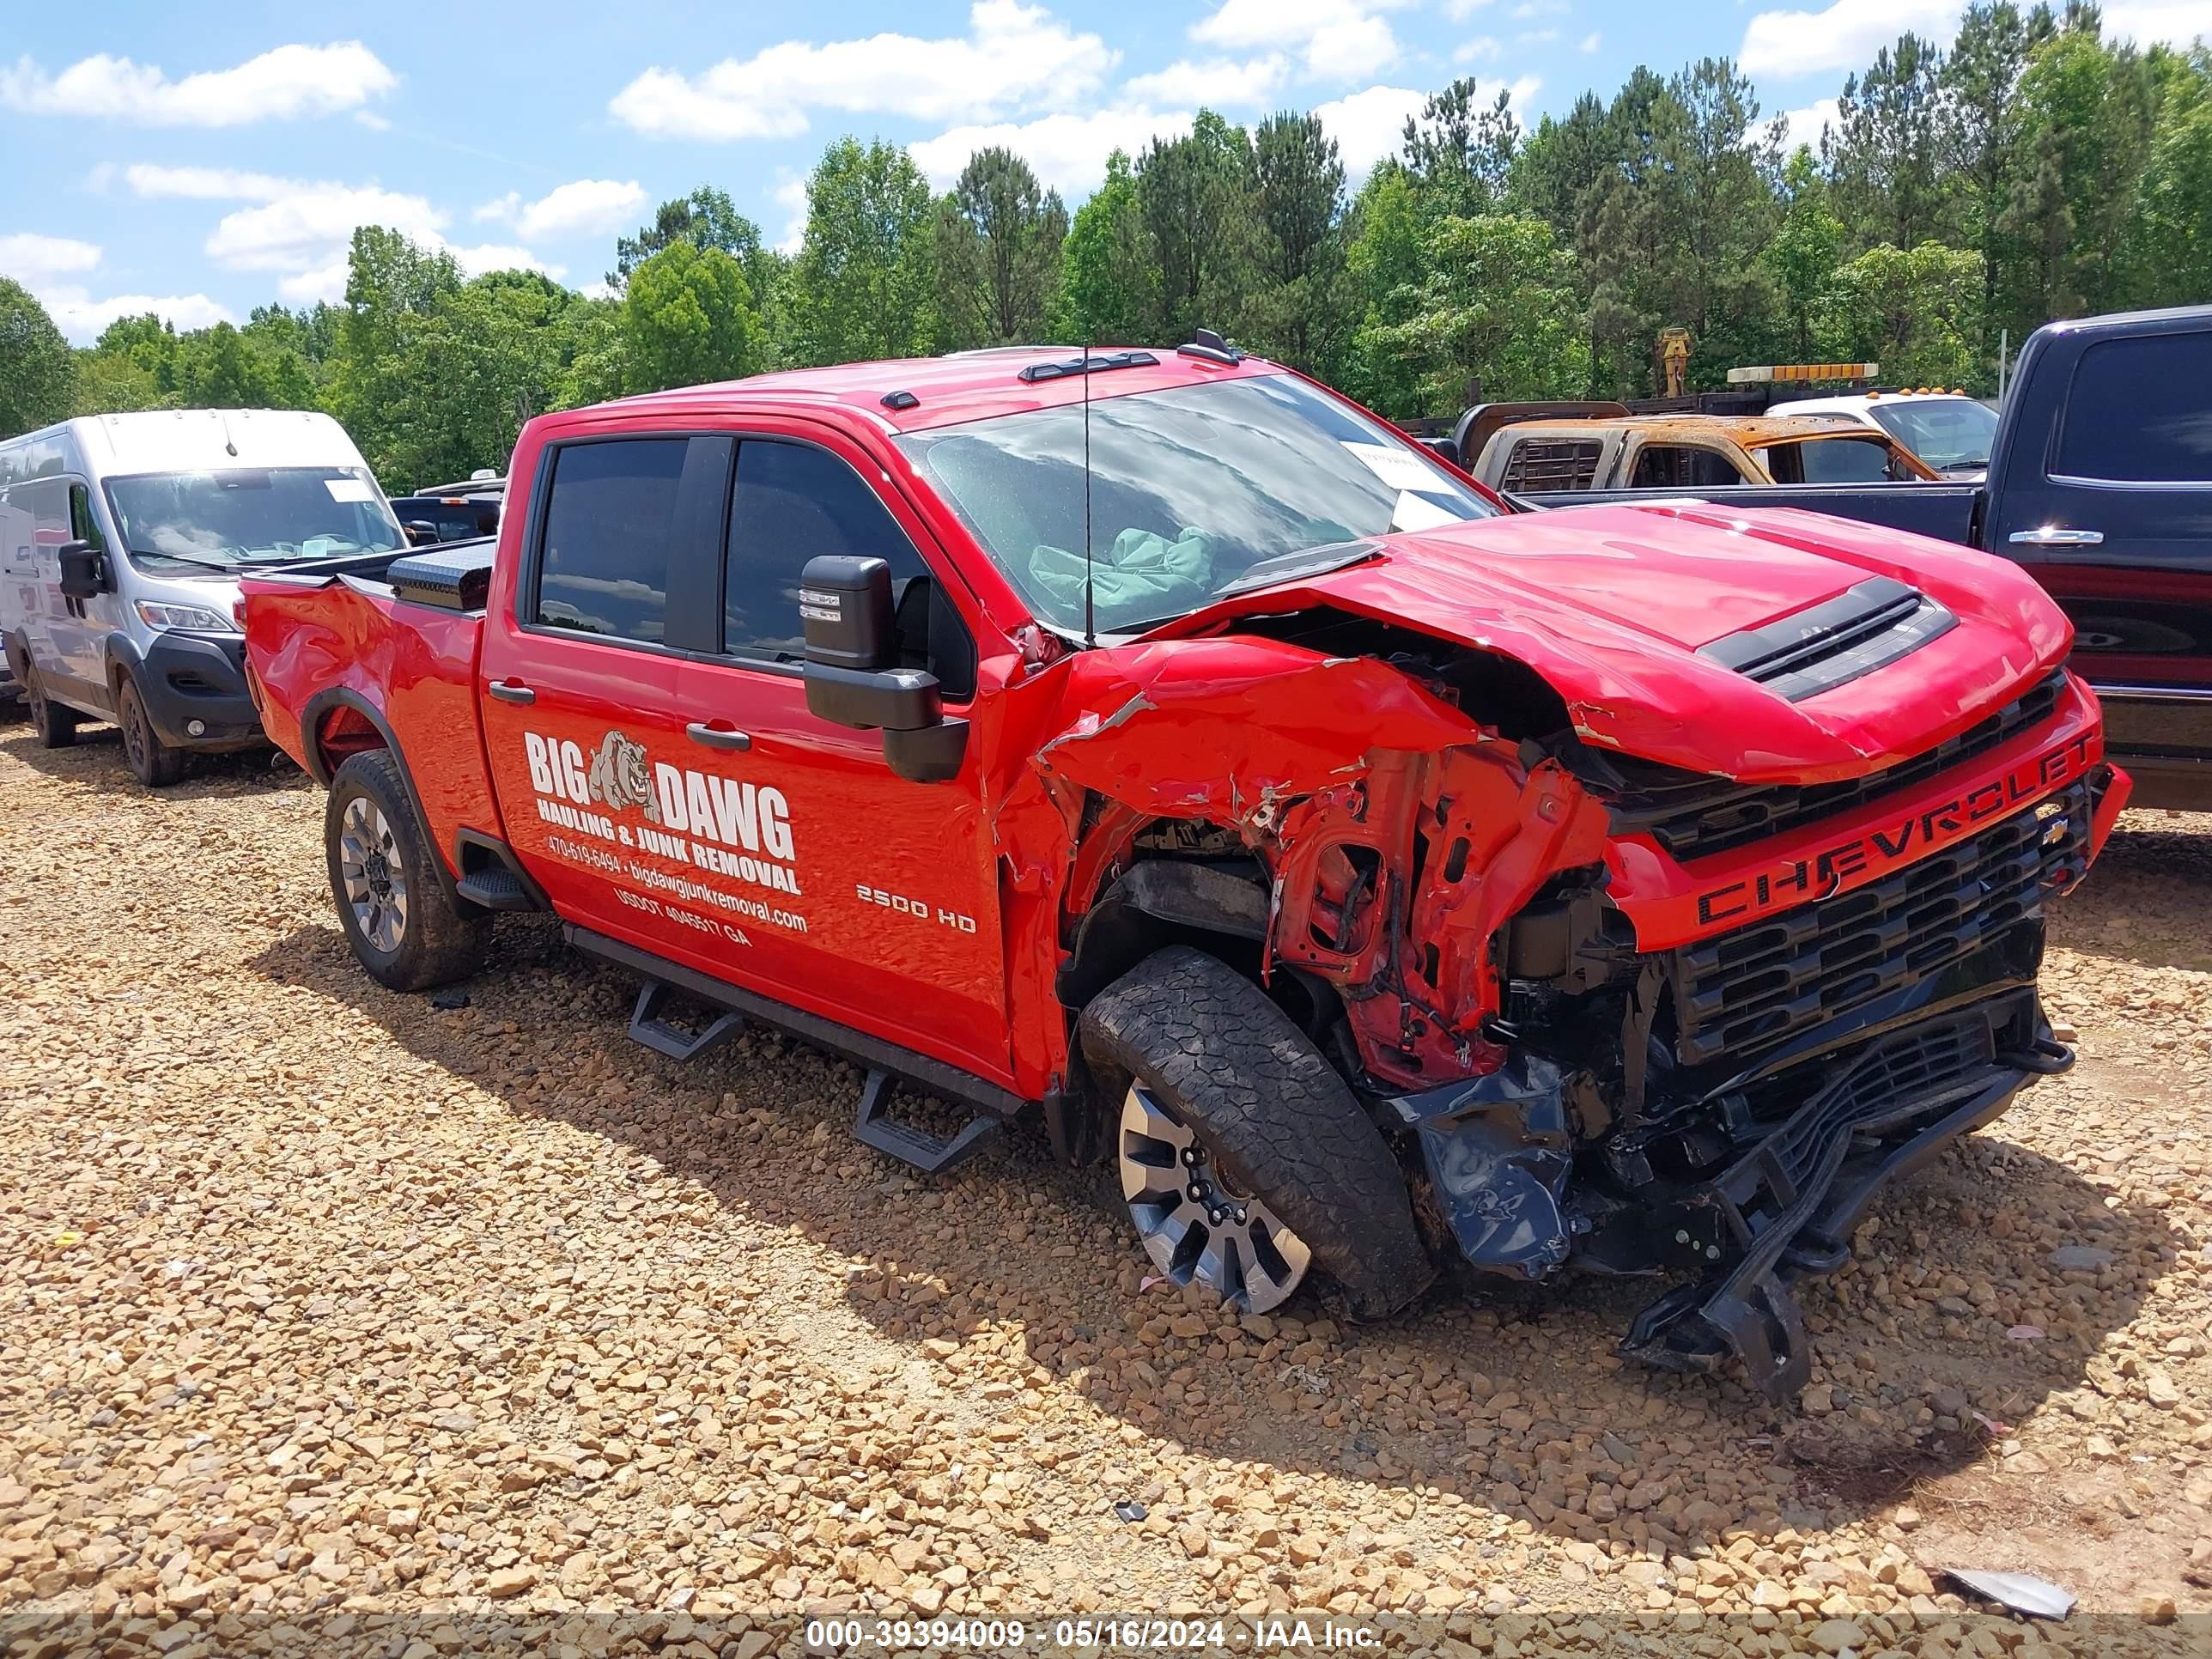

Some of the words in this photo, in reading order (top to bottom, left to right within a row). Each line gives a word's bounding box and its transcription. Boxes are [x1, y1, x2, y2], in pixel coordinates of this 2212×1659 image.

[524, 731, 591, 805] BIG
[655, 762, 796, 861] DAWG
[1697, 733, 2091, 925] CHEVROLET
[537, 799, 616, 842] HAULING
[618, 825, 634, 847] &
[636, 827, 690, 864] JUNK
[691, 842, 803, 896] REMOVAL
[549, 836, 621, 874] 470-619-6494
[630, 860, 808, 933] bigdawgjunkremoval.com
[613, 887, 665, 917] USDOT
[665, 904, 723, 939] 4045517
[724, 924, 753, 947] GA
[856, 884, 928, 919] 2500
[938, 908, 976, 934] HD
